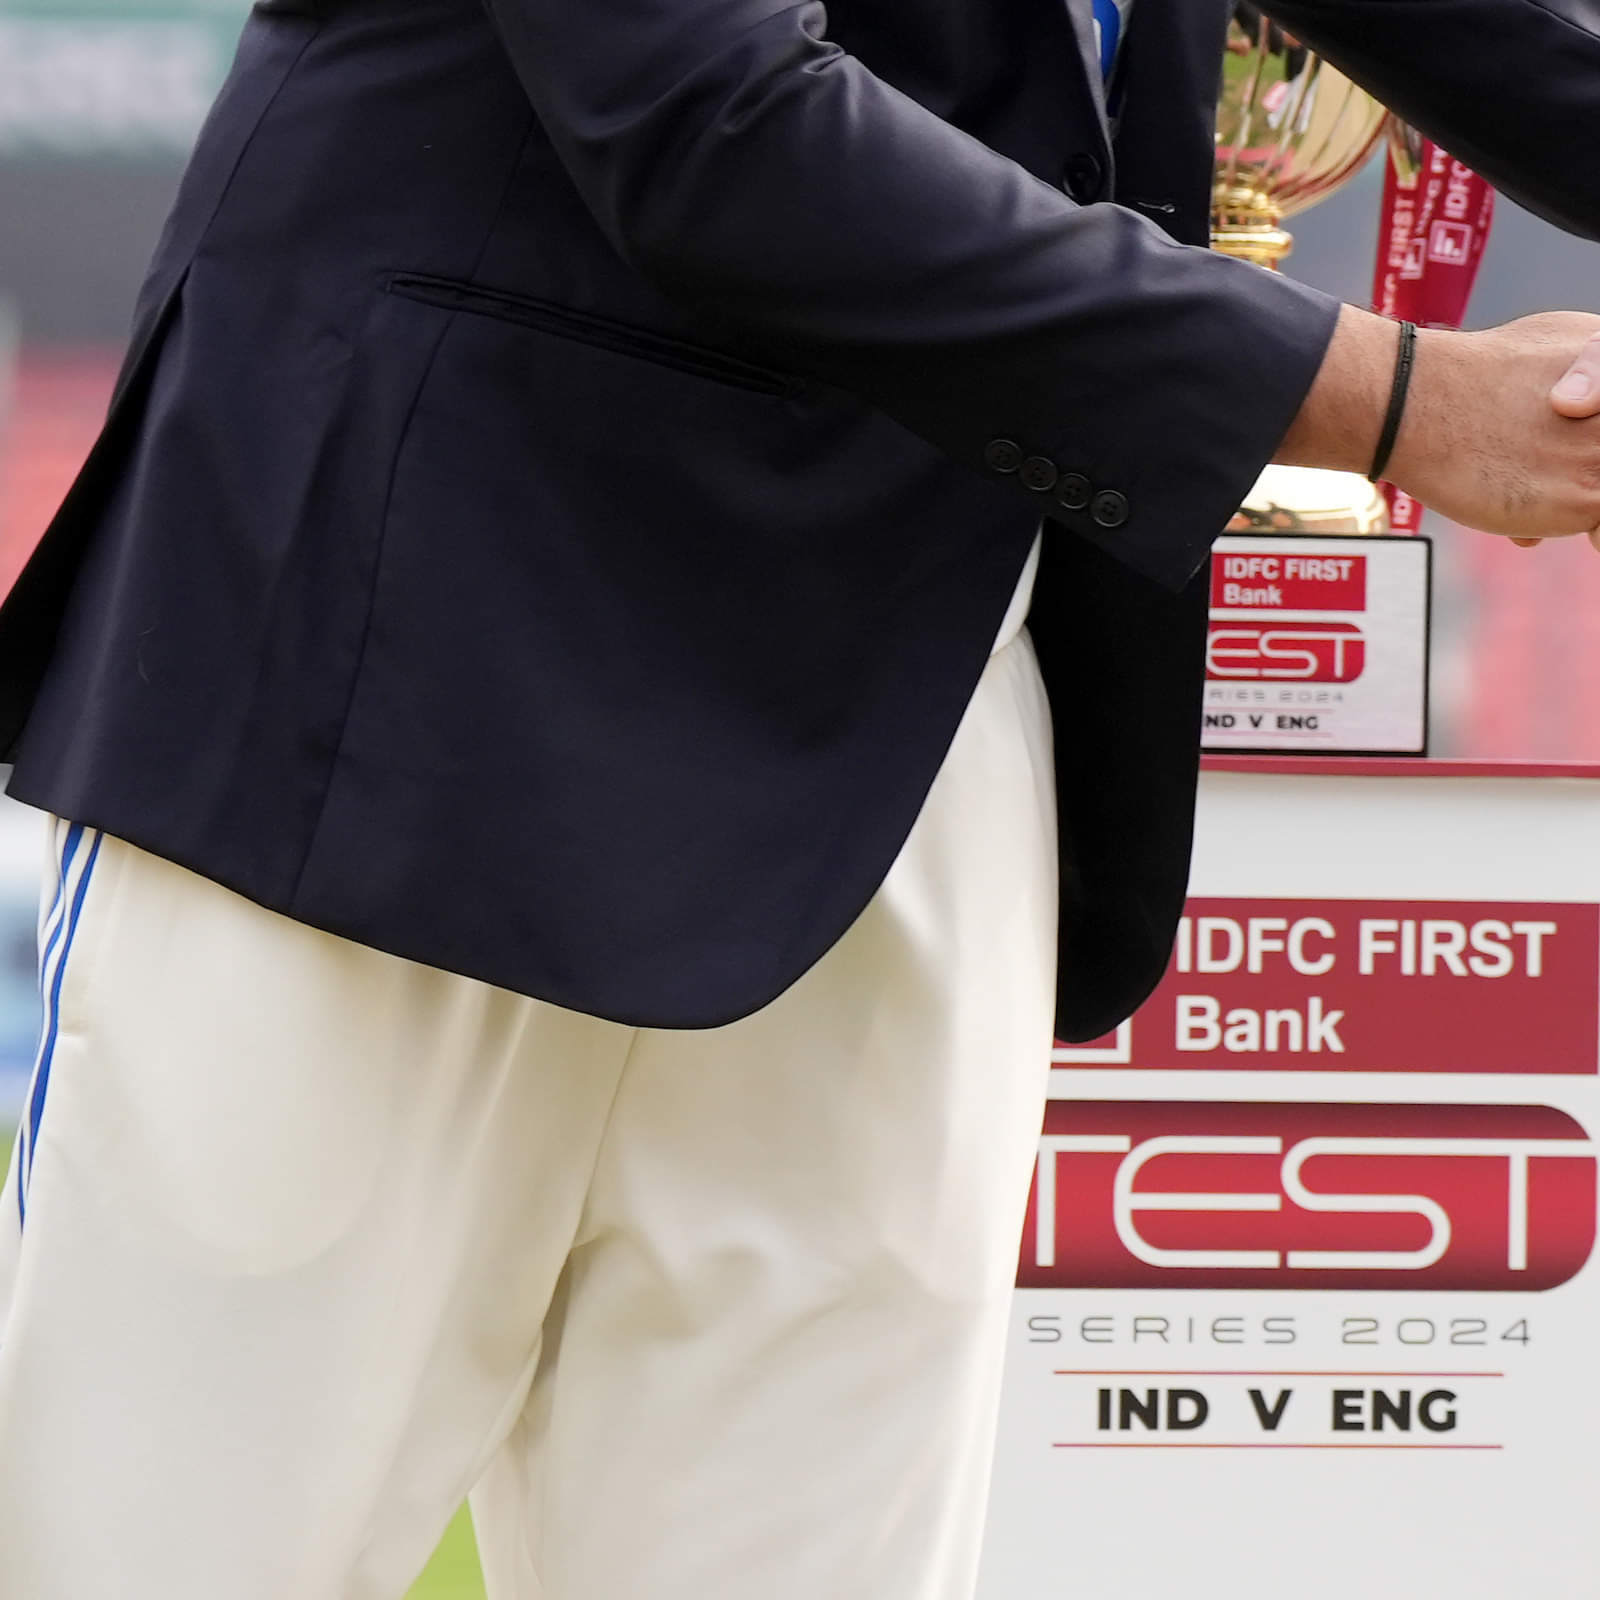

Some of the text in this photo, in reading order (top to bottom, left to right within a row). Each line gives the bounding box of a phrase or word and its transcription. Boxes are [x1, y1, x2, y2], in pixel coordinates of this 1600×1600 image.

[1388, 193, 1415, 268] FIRST
[1224, 557, 1353, 582] IDFC FIRST
[1223, 584, 1282, 606] Bank
[1206, 629, 1365, 679] EST
[1208, 688, 1344, 704] RIES 2024
[1205, 713, 1319, 731] ND V ENG
[1177, 917, 1557, 978] IDFC FIRST
[1176, 995, 1344, 1053] Bank
[1036, 1134, 1597, 1270] TEST
[1028, 1316, 1532, 1347] SERIES 2024
[1097, 1388, 1457, 1433] IND V ENG
